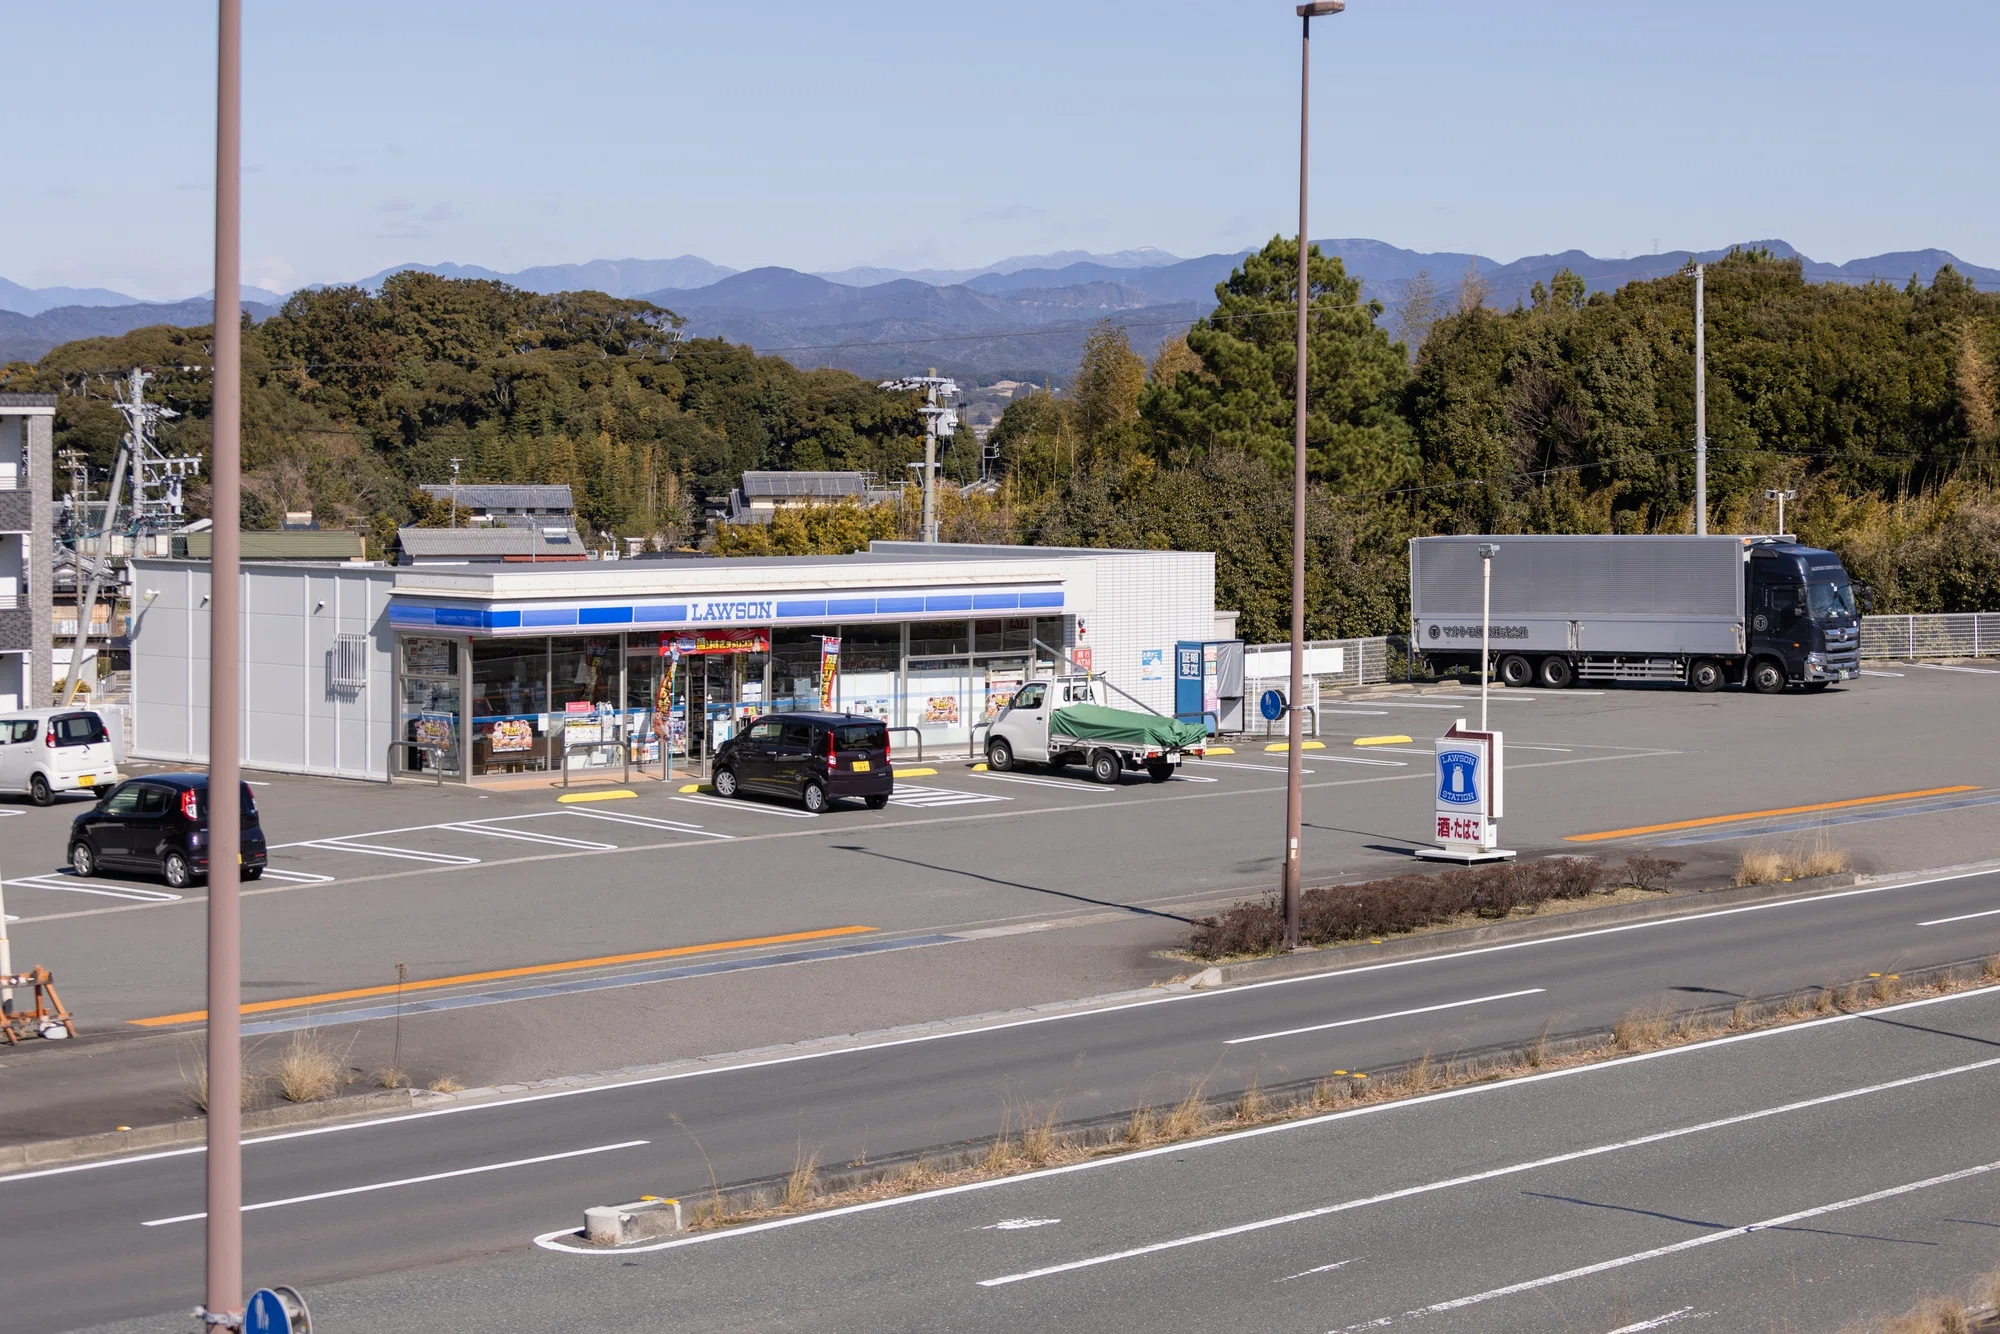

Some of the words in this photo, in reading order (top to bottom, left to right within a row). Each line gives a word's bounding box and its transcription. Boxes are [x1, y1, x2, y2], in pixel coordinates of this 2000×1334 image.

[691, 601, 772, 621] LAWSON
[1076, 659, 1091, 668] ATM
[1441, 754, 1475, 766] LAWSON
[1442, 790, 1475, 801] STATION
[1437, 816, 1480, 841] 酒・たばこ
